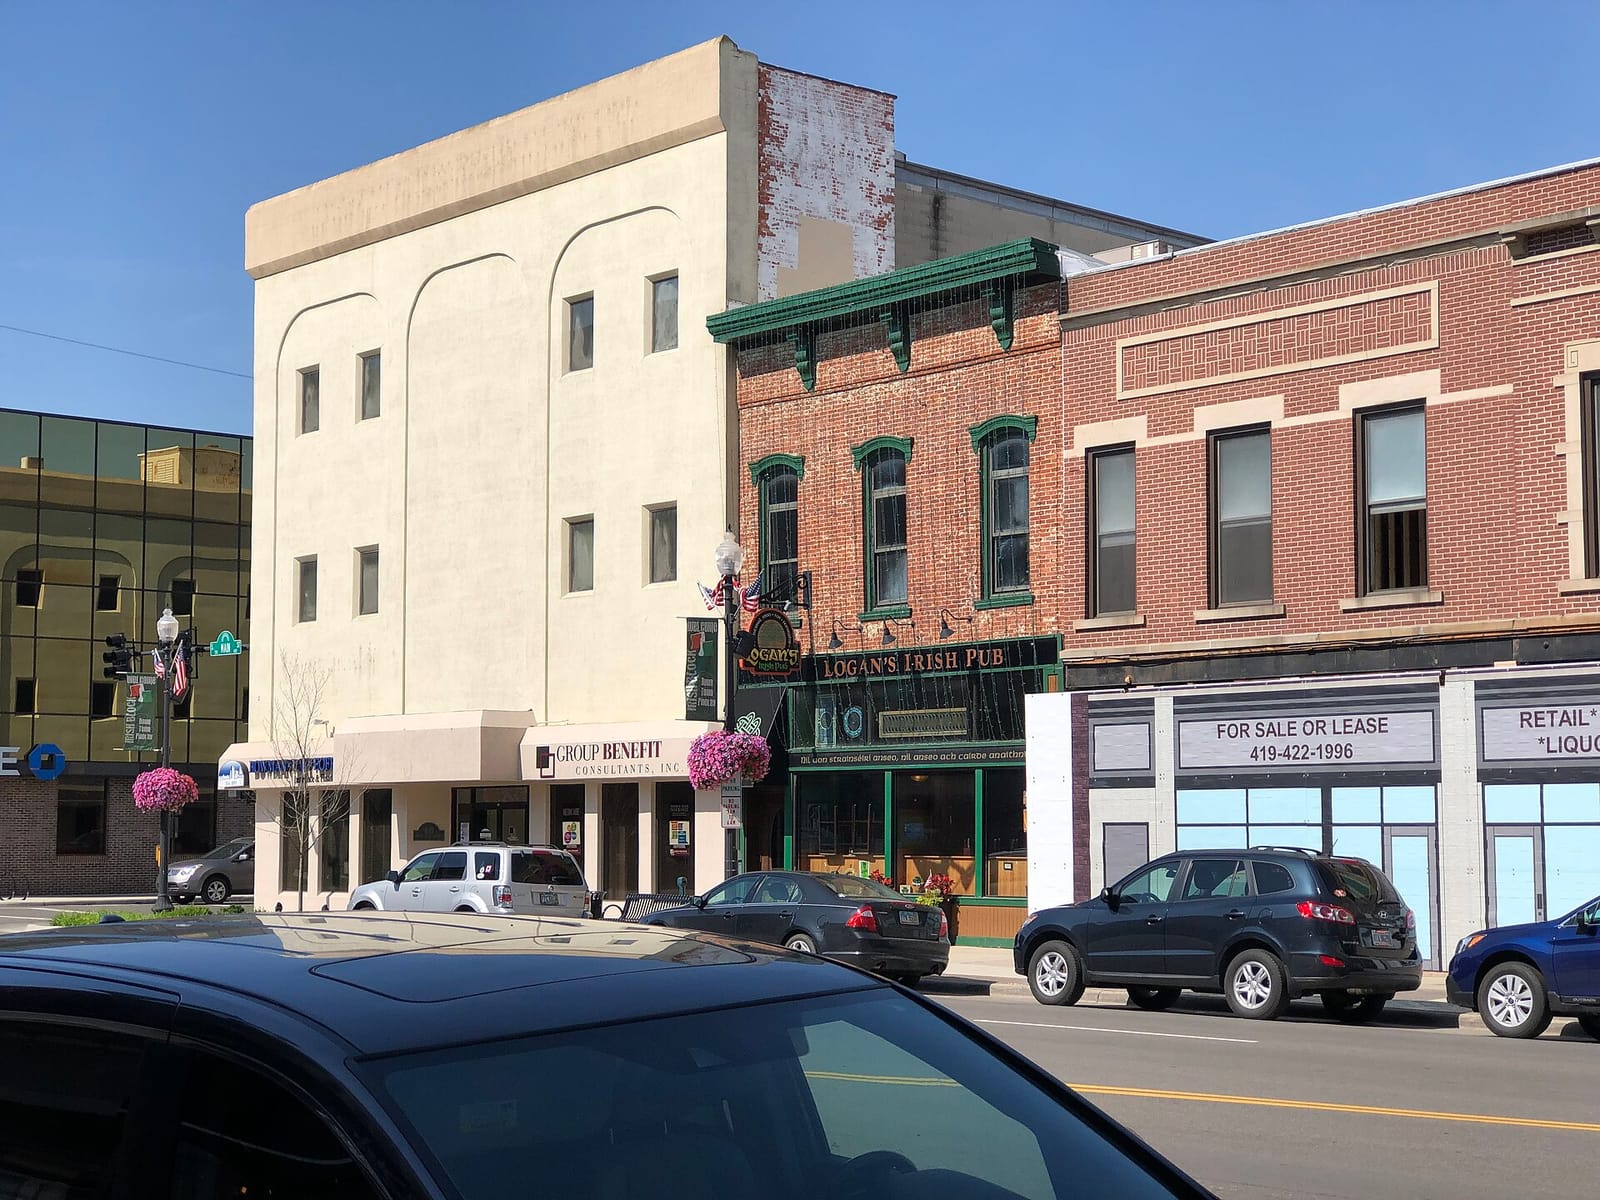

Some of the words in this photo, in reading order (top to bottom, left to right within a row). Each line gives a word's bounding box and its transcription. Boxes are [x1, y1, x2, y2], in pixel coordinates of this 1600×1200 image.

[824, 655, 897, 678] LOGAN'S
[904, 651, 958, 672] IRISH
[965, 647, 1004, 667] PUB
[1217, 722, 1251, 739] FOR
[1255, 720, 1298, 738] SALE
[1302, 719, 1327, 736] OR
[1332, 717, 1389, 735] LEASE
[556, 744, 600, 763] GROUP
[603, 740, 663, 760] BENEFIT
[1250, 742, 1354, 762] 419-422-1996
[575, 763, 655, 776] CONSULTANTS,
[660, 762, 685, 773] INC.
